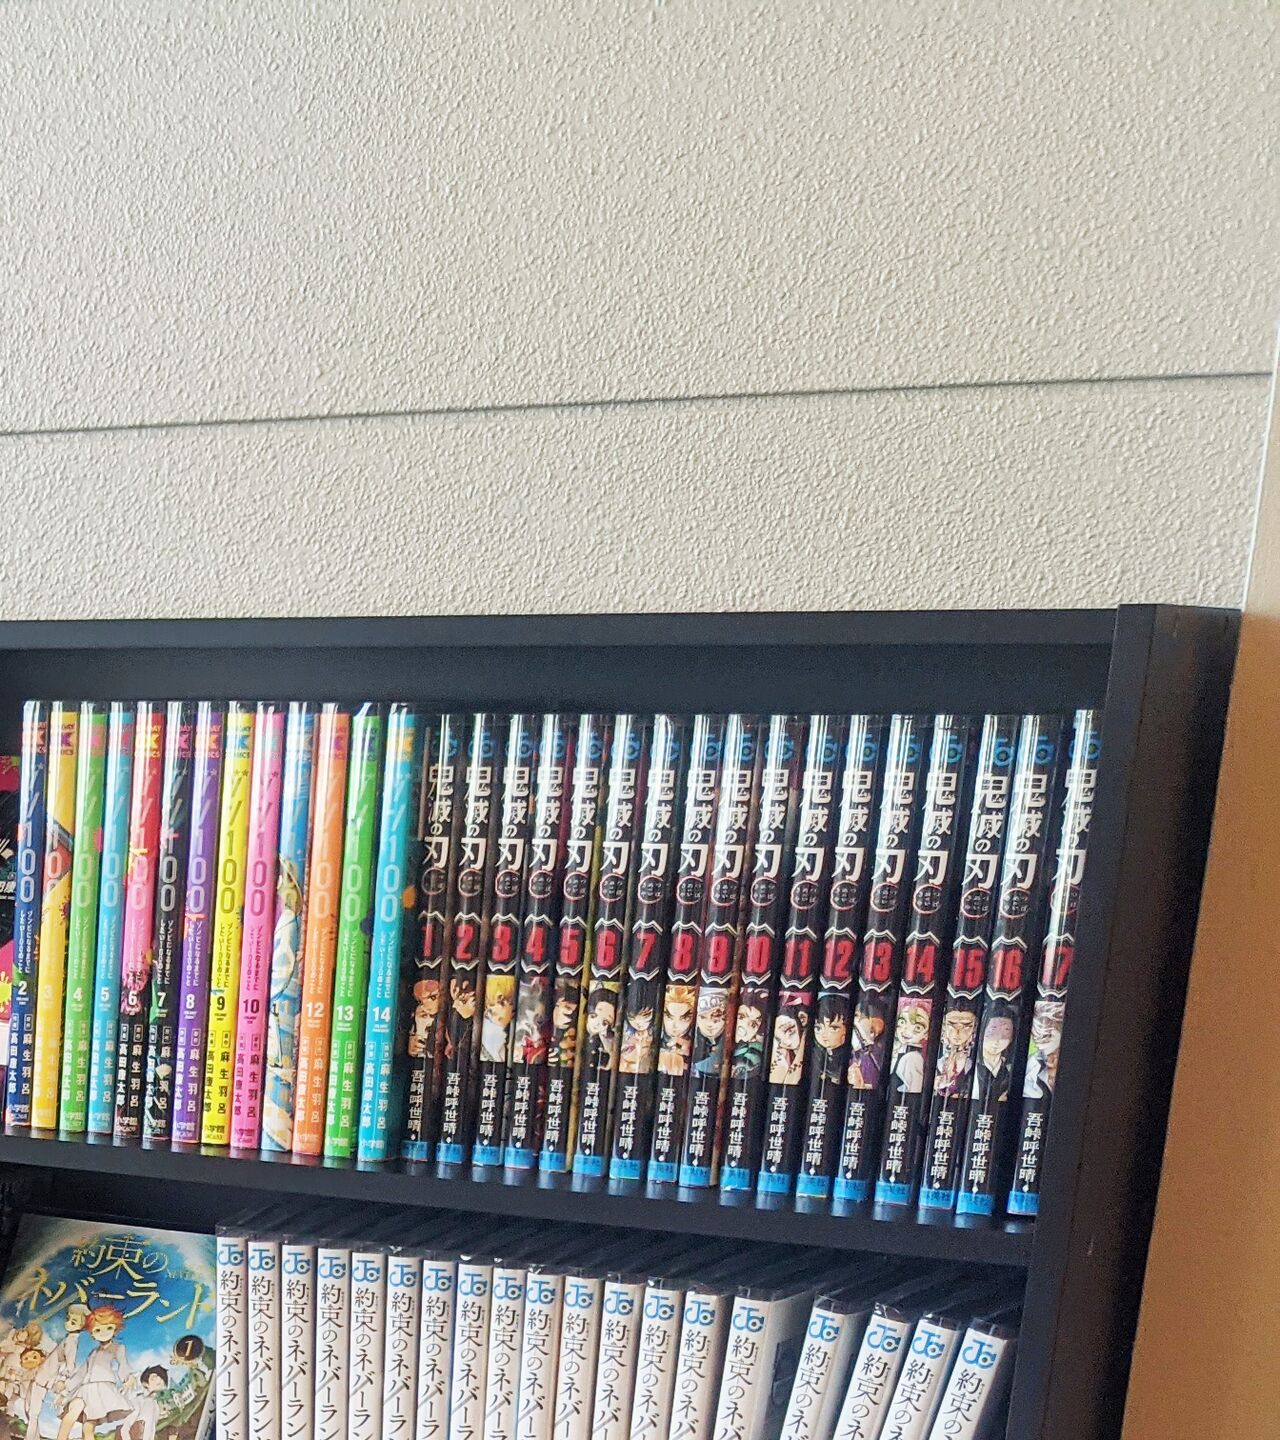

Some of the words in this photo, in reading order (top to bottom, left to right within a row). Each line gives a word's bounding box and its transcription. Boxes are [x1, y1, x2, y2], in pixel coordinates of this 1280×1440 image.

[456, 924, 474, 960] 2
[492, 925, 511, 961] 3
[560, 929, 579, 965] 5
[597, 930, 616, 967] 6
[672, 934, 694, 971] 8
[708, 935, 728, 973] 9
[824, 940, 854, 978] 12
[905, 943, 935, 983] 14
[992, 948, 1024, 989] 16
[18, 981, 29, 996] 2
[101, 987, 110, 1000] 5
[128, 992, 137, 1006] 6
[157, 992, 166, 1007] 7
[186, 994, 195, 1009] 8
[216, 995, 225, 1011] 9
[243, 998, 259, 1014] 10
[336, 1005, 354, 1021] 13
[372, 1006, 390, 1022] 14
[116, 1045, 128, 1110] 高田康太郎
[130, 1045, 142, 1107] 麻生羽呂
[217, 1050, 230, 1115] 麻生羽呂
[442, 1072, 461, 1135] 吾峠呼世晴
[618, 1085, 638, 1151] 吾峠呼世晴
[805, 1098, 828, 1166] 吾峠呼世晴
[885, 1105, 909, 1174] 吾峠呼世晴
[72, 1235, 168, 1280] 約束の
[15, 1267, 212, 1330] ネバーランド
[184, 1340, 193, 1356] 1
